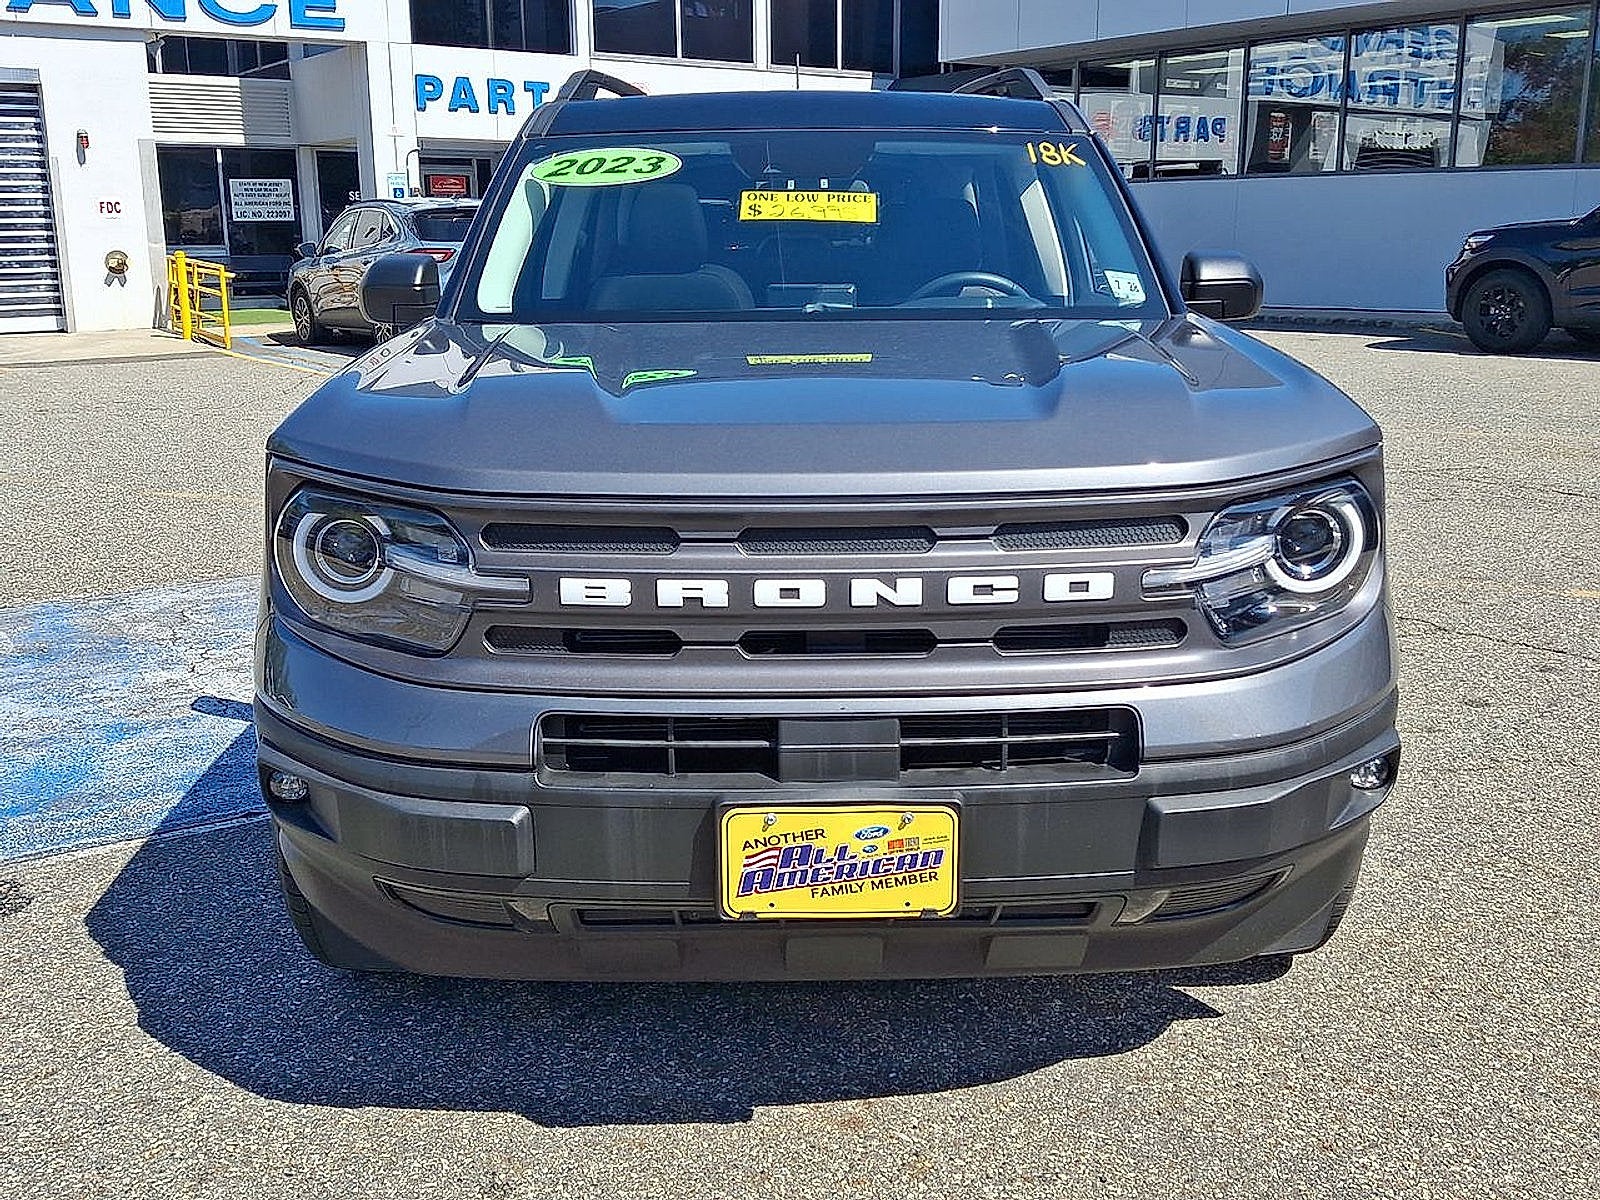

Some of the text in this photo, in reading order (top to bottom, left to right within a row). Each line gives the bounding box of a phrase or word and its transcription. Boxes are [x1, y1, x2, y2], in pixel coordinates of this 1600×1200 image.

[1026, 142, 1087, 166] 18K
[543, 156, 667, 178] 2023
[99, 201, 121, 213] FDC
[747, 193, 873, 204] ONE LOW PRICE
[559, 572, 1115, 608] BRONCO
[742, 829, 827, 851] ANOTHER
[858, 827, 888, 839] Ford
[779, 844, 857, 868] ALL
[739, 849, 944, 894] AMERICAN
[811, 871, 939, 898] FAMILY MEMBER
